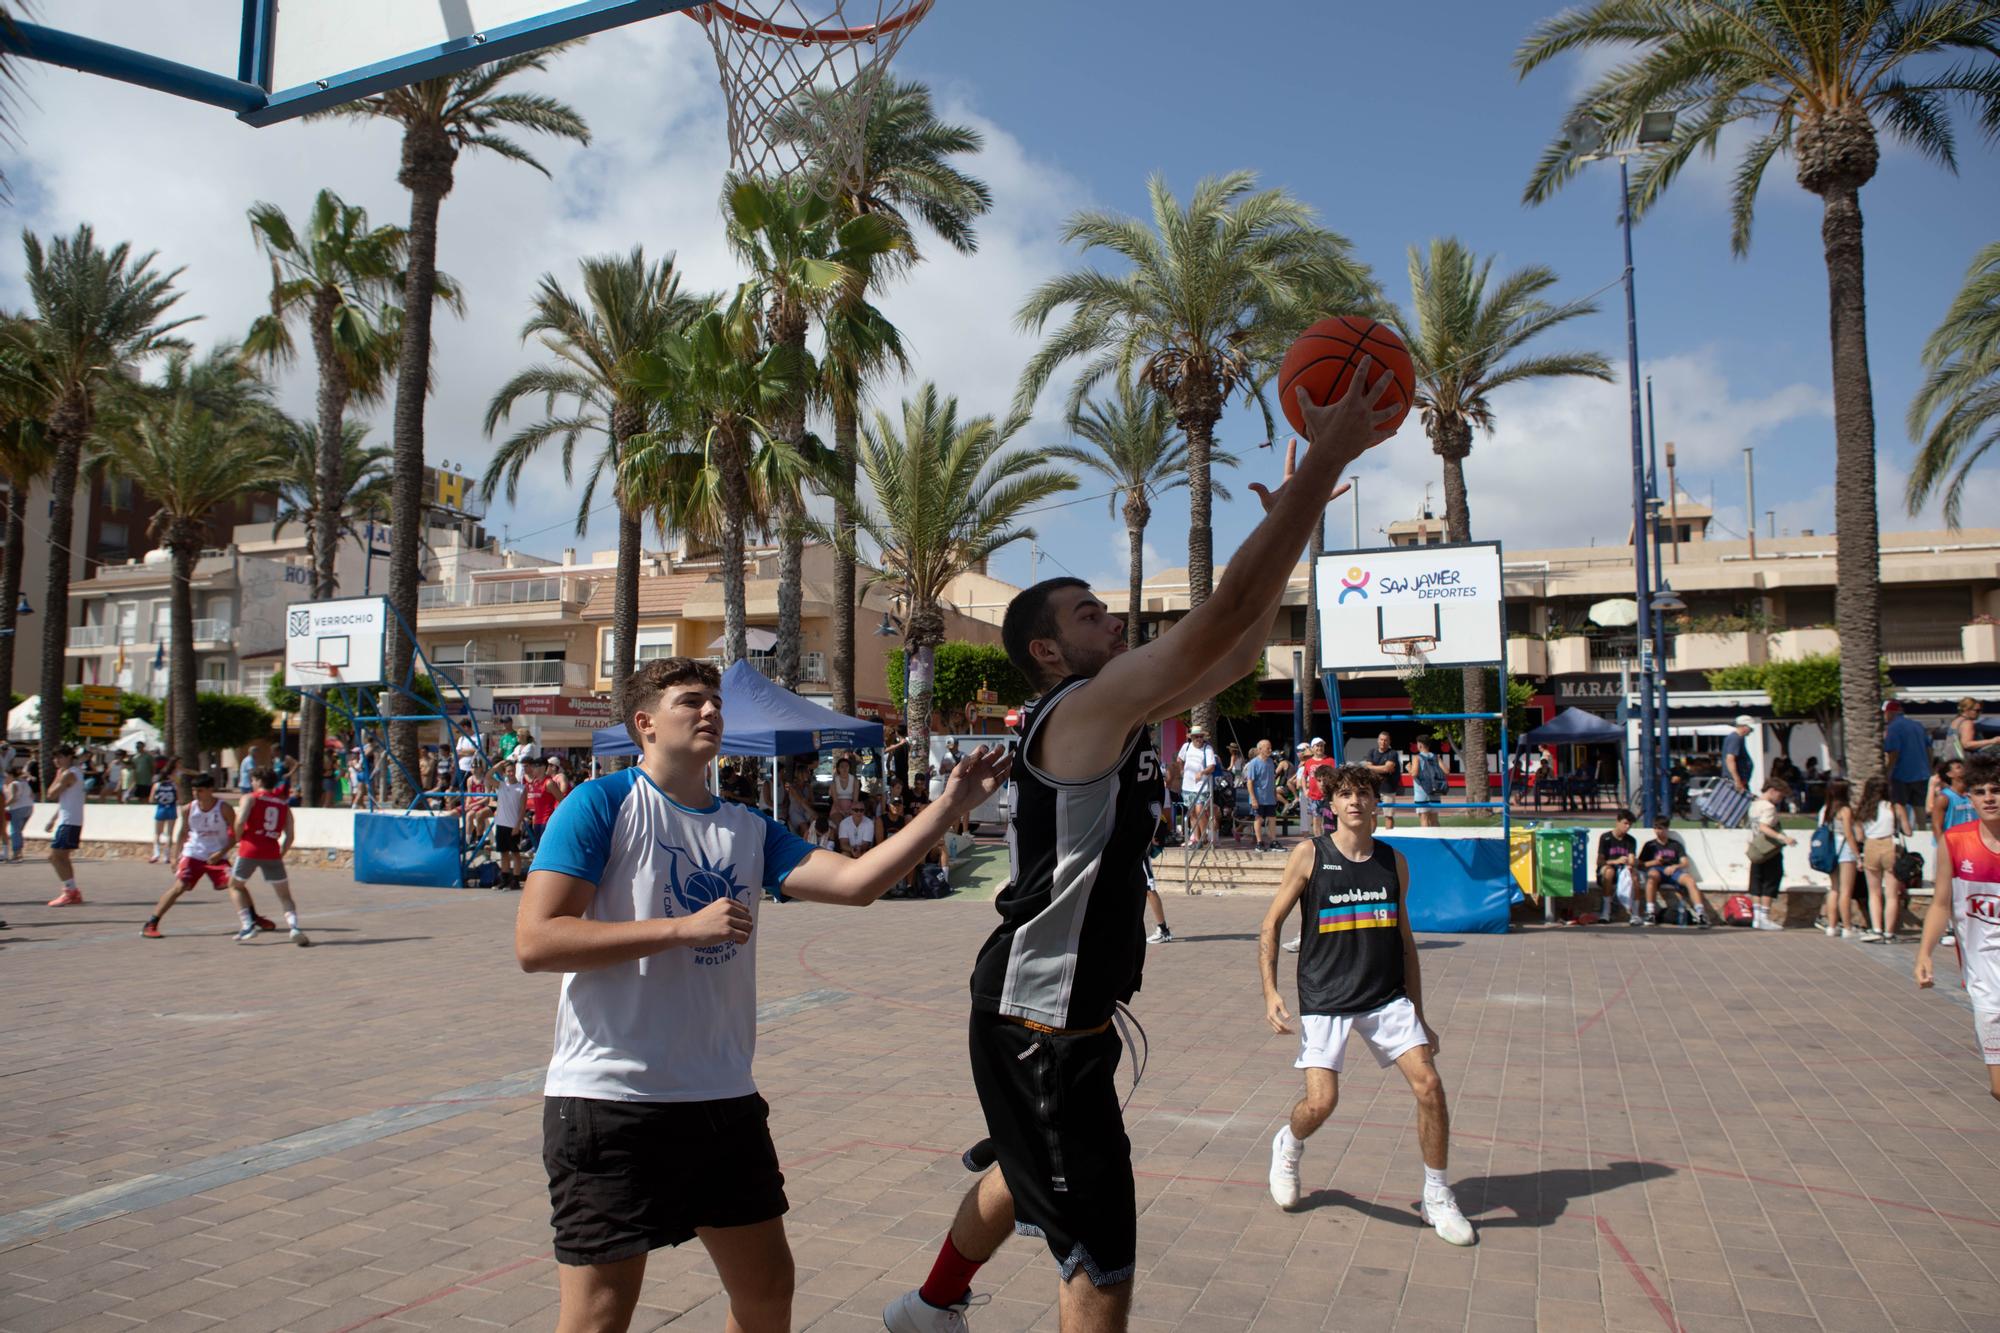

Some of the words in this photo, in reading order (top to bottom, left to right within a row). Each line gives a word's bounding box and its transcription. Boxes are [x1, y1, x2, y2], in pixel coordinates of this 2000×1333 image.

[436, 471, 464, 511] H
[1379, 577, 1409, 594] SAN
[1411, 570, 1461, 592] JAVIER
[1418, 587, 1477, 599] DEPORTES
[314, 614, 373, 626] VERROCHIO
[263, 806, 279, 831] 9
[1373, 909, 1388, 921] 19
[1971, 898, 2000, 918] KI
